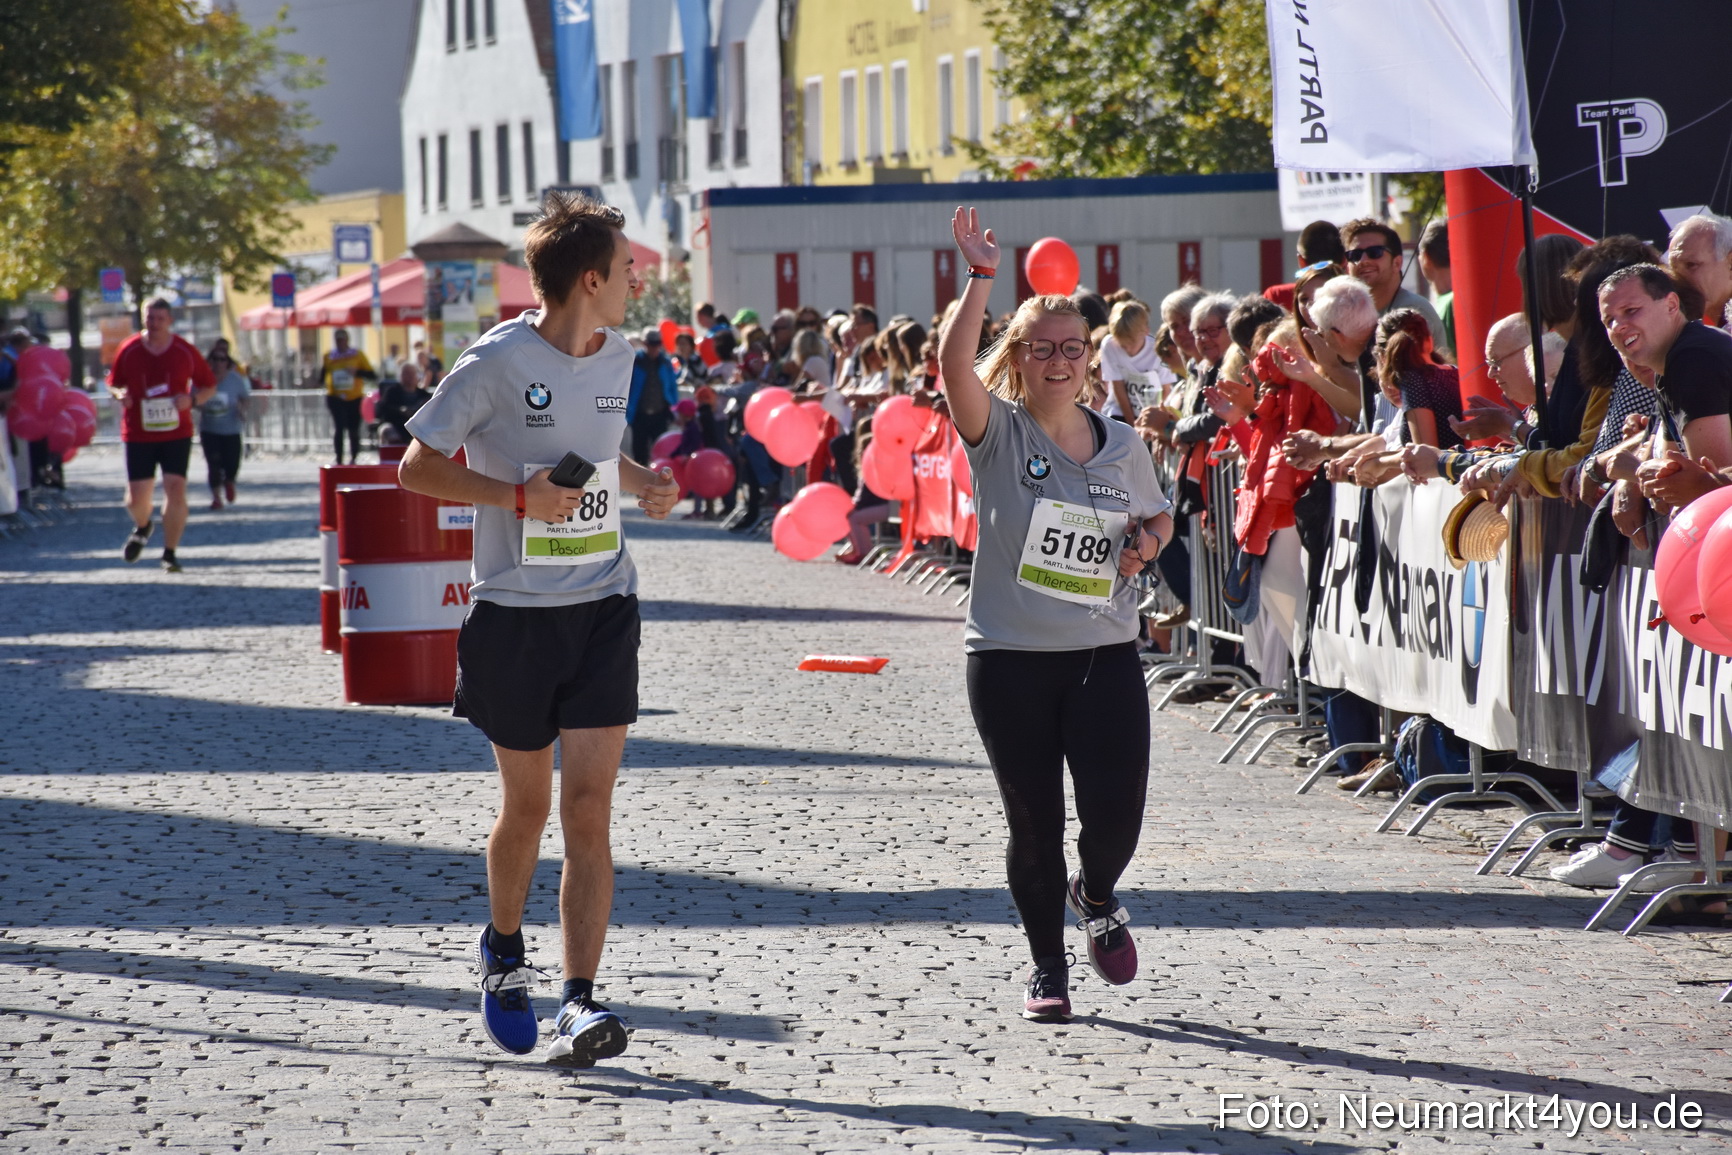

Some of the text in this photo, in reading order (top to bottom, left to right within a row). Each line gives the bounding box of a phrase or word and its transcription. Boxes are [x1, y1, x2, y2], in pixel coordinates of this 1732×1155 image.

[526, 414, 555, 422] PARTL
[1088, 484, 1131, 503] BOCK
[570, 525, 597, 534] Neumarkt
[1061, 511, 1106, 530] BOCK
[548, 538, 588, 556] Pascal
[1041, 527, 1112, 565] 5189
[1043, 559, 1092, 574] PARTL Neumarkt
[1033, 569, 1088, 593] Theresa
